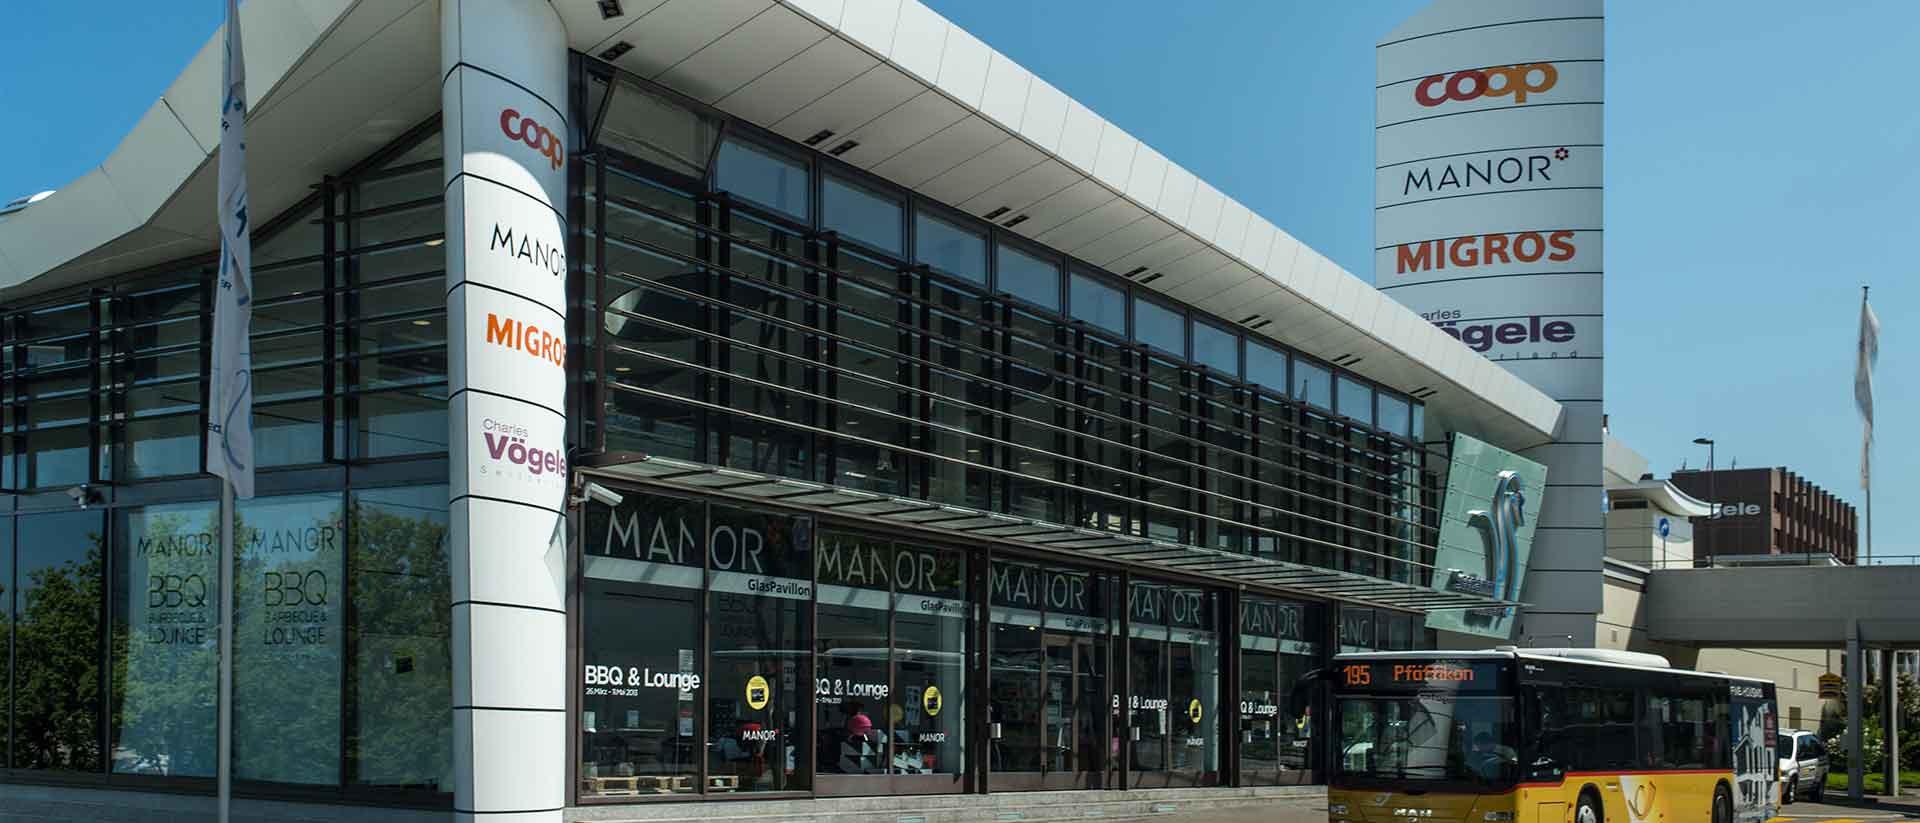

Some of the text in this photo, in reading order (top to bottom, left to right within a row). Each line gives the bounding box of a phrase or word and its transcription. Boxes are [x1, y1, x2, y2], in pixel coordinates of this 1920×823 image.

[1414, 62, 1558, 107] coop
[500, 108, 563, 170] coop
[1403, 155, 1552, 196] MANOR
[1397, 230, 1576, 274] MIGROS
[1420, 310, 1462, 321] arles
[1431, 316, 1576, 353] gele
[483, 418, 528, 438] Charles
[484, 432, 566, 478] Vögele
[137, 533, 213, 559] MANOR
[248, 526, 336, 555] MANOR
[604, 506, 763, 573] MANOR
[816, 540, 937, 592] MANOR
[149, 574, 206, 609] BBQ
[264, 570, 328, 607] BBQ
[748, 579, 811, 597] GlasPavillon
[990, 565, 1085, 610] MANOR
[264, 626, 326, 645] LOUNGE
[584, 664, 701, 692] BBQ & Lounge
[1343, 664, 1371, 685] 195
[834, 679, 843, 696] &
[846, 680, 889, 700] Lounge
[1132, 695, 1139, 708] &
[1141, 697, 1168, 711] Lounge
[1255, 703, 1278, 717] Lounge
[742, 730, 776, 741] MANOR
